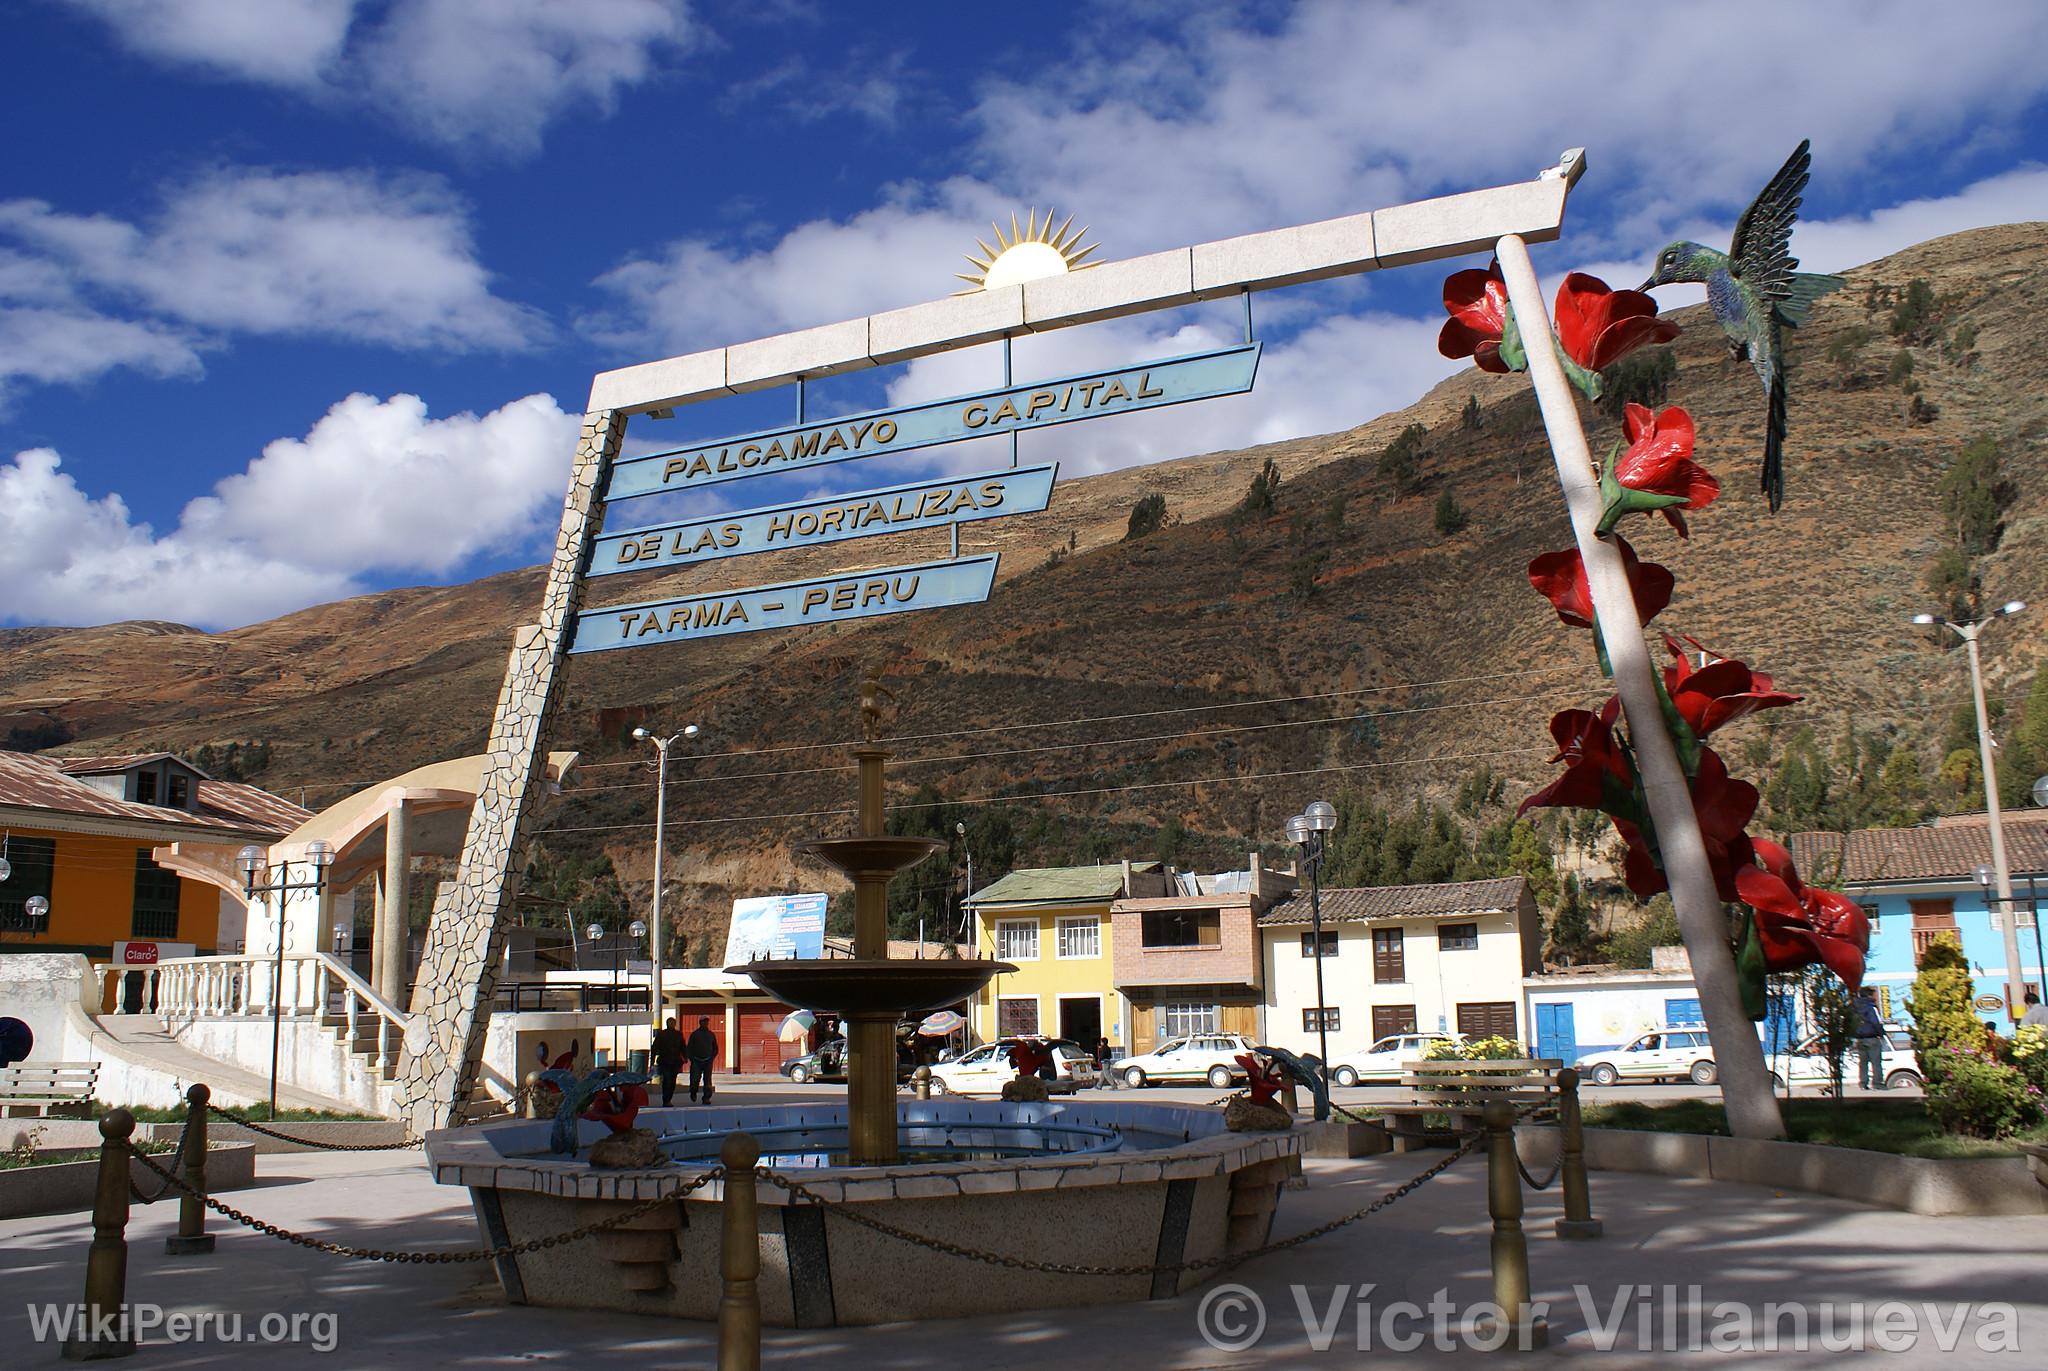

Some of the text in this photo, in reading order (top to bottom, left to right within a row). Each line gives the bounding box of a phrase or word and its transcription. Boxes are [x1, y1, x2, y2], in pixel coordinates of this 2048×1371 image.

[663, 371, 1164, 484] PALCAMAYO CAPITAL
[616, 480, 1006, 564] DE LAS HORTALIZAS
[619, 598, 750, 638] TARMA
[802, 574, 920, 614] PERU
[126, 950, 152, 960] Claro
